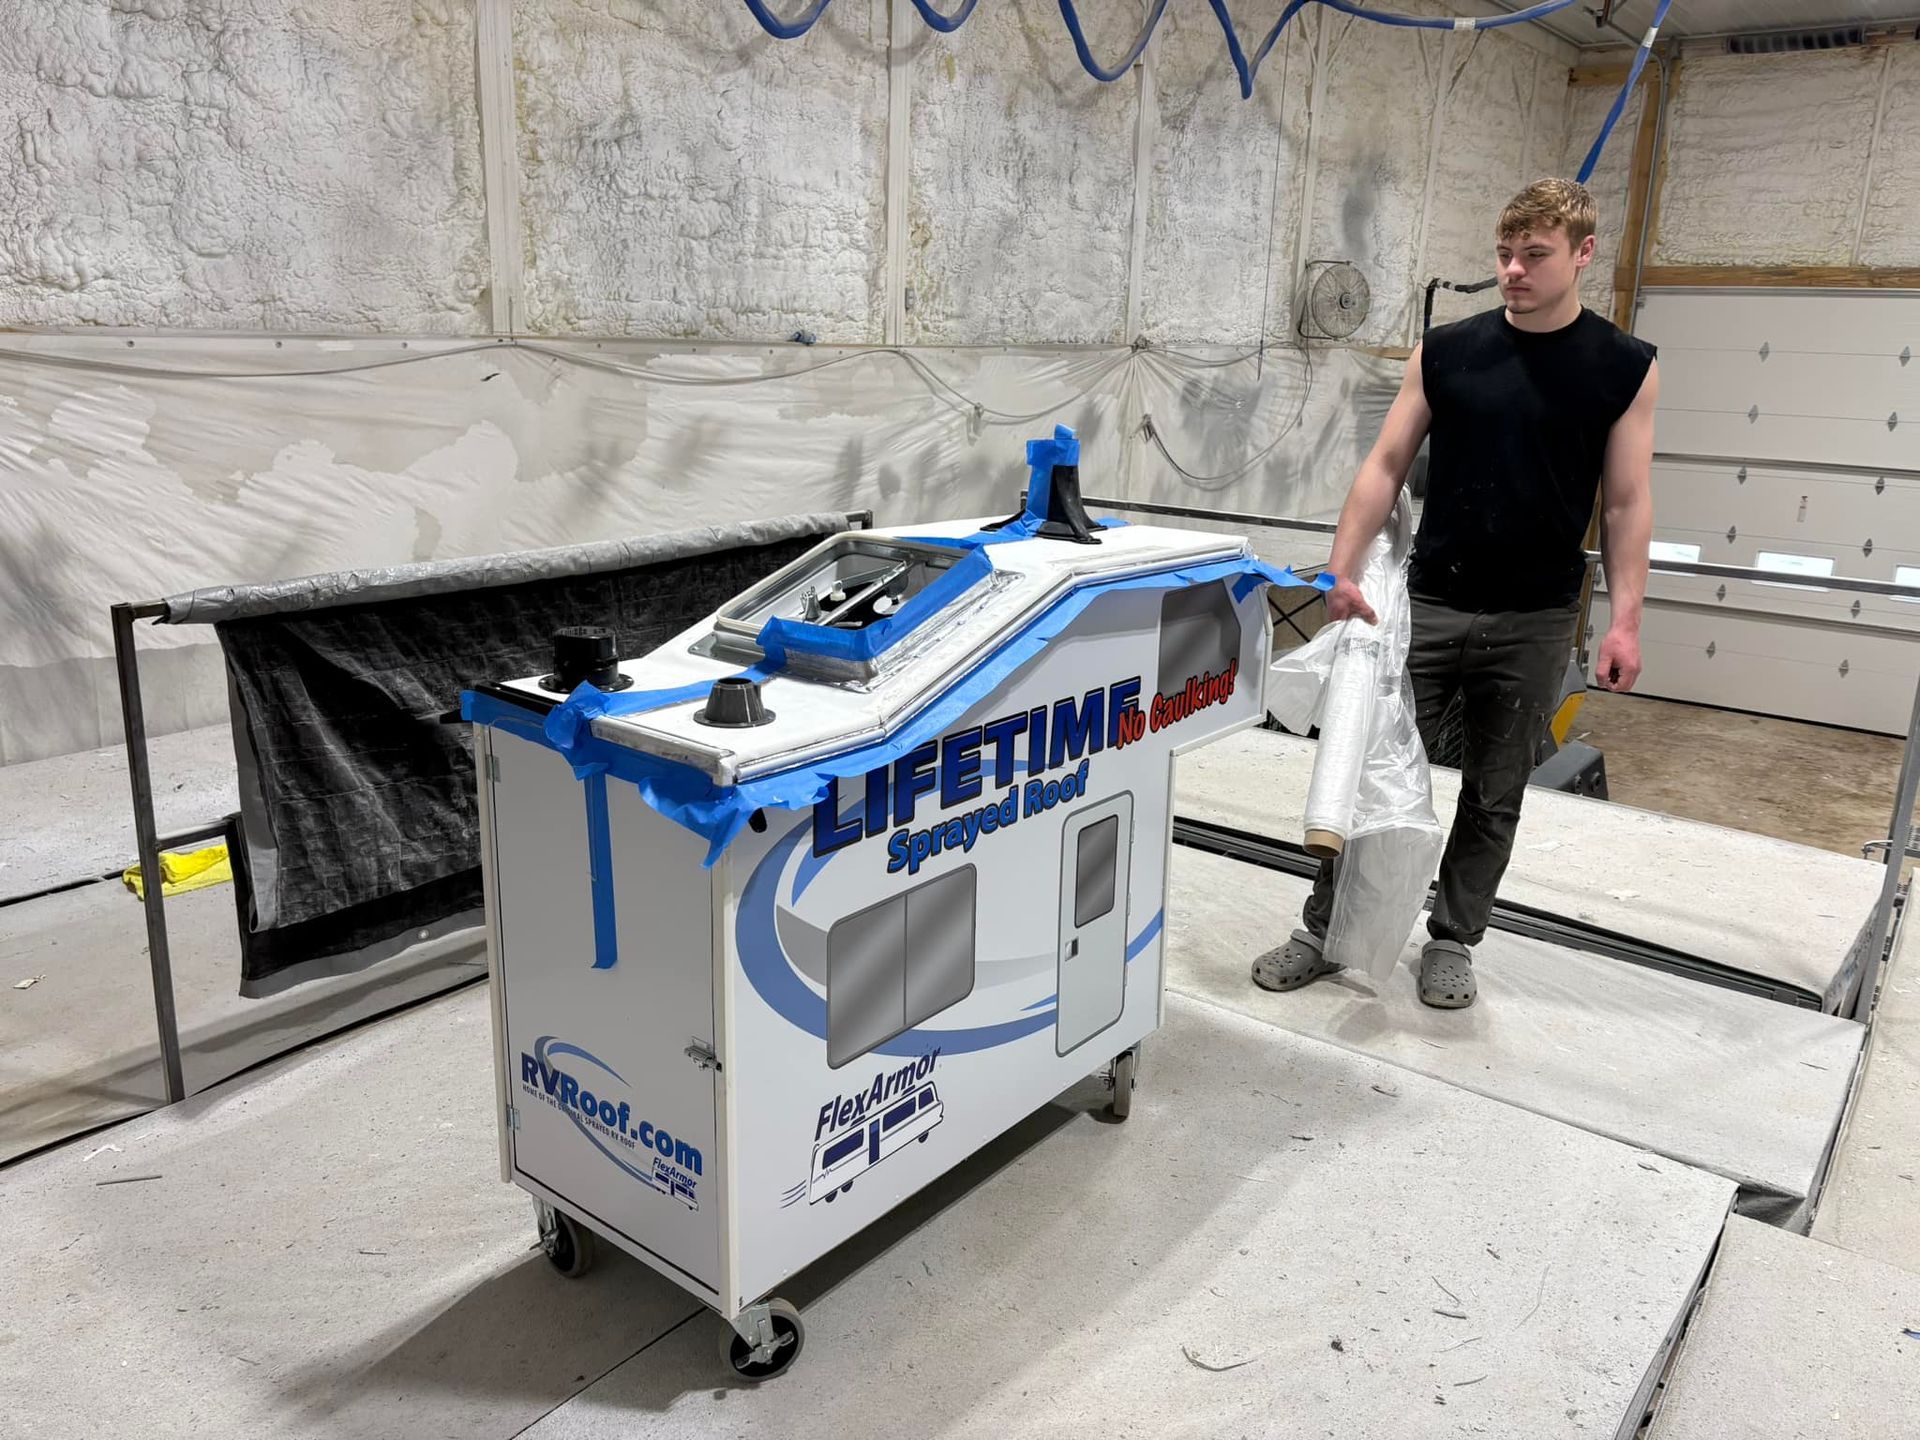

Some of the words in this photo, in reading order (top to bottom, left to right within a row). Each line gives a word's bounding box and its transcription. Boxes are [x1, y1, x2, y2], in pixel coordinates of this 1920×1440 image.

[1116, 705, 1146, 750] No
[1150, 657, 1238, 733] Caulking!
[813, 675, 1141, 858] LIFETIME
[887, 784, 1018, 875] Sprayed
[1023, 758, 1090, 819] Roof
[521, 1052, 703, 1176] RVRoof.com
[522, 1083, 538, 1098] HOME
[539, 1092, 546, 1101] OF
[546, 1096, 557, 1109] THE
[585, 1117, 610, 1136] SPRAYED
[620, 1135, 636, 1149] ROOF
[814, 1046, 942, 1142] FlexArmor
[653, 1156, 698, 1189] FlexArmor
